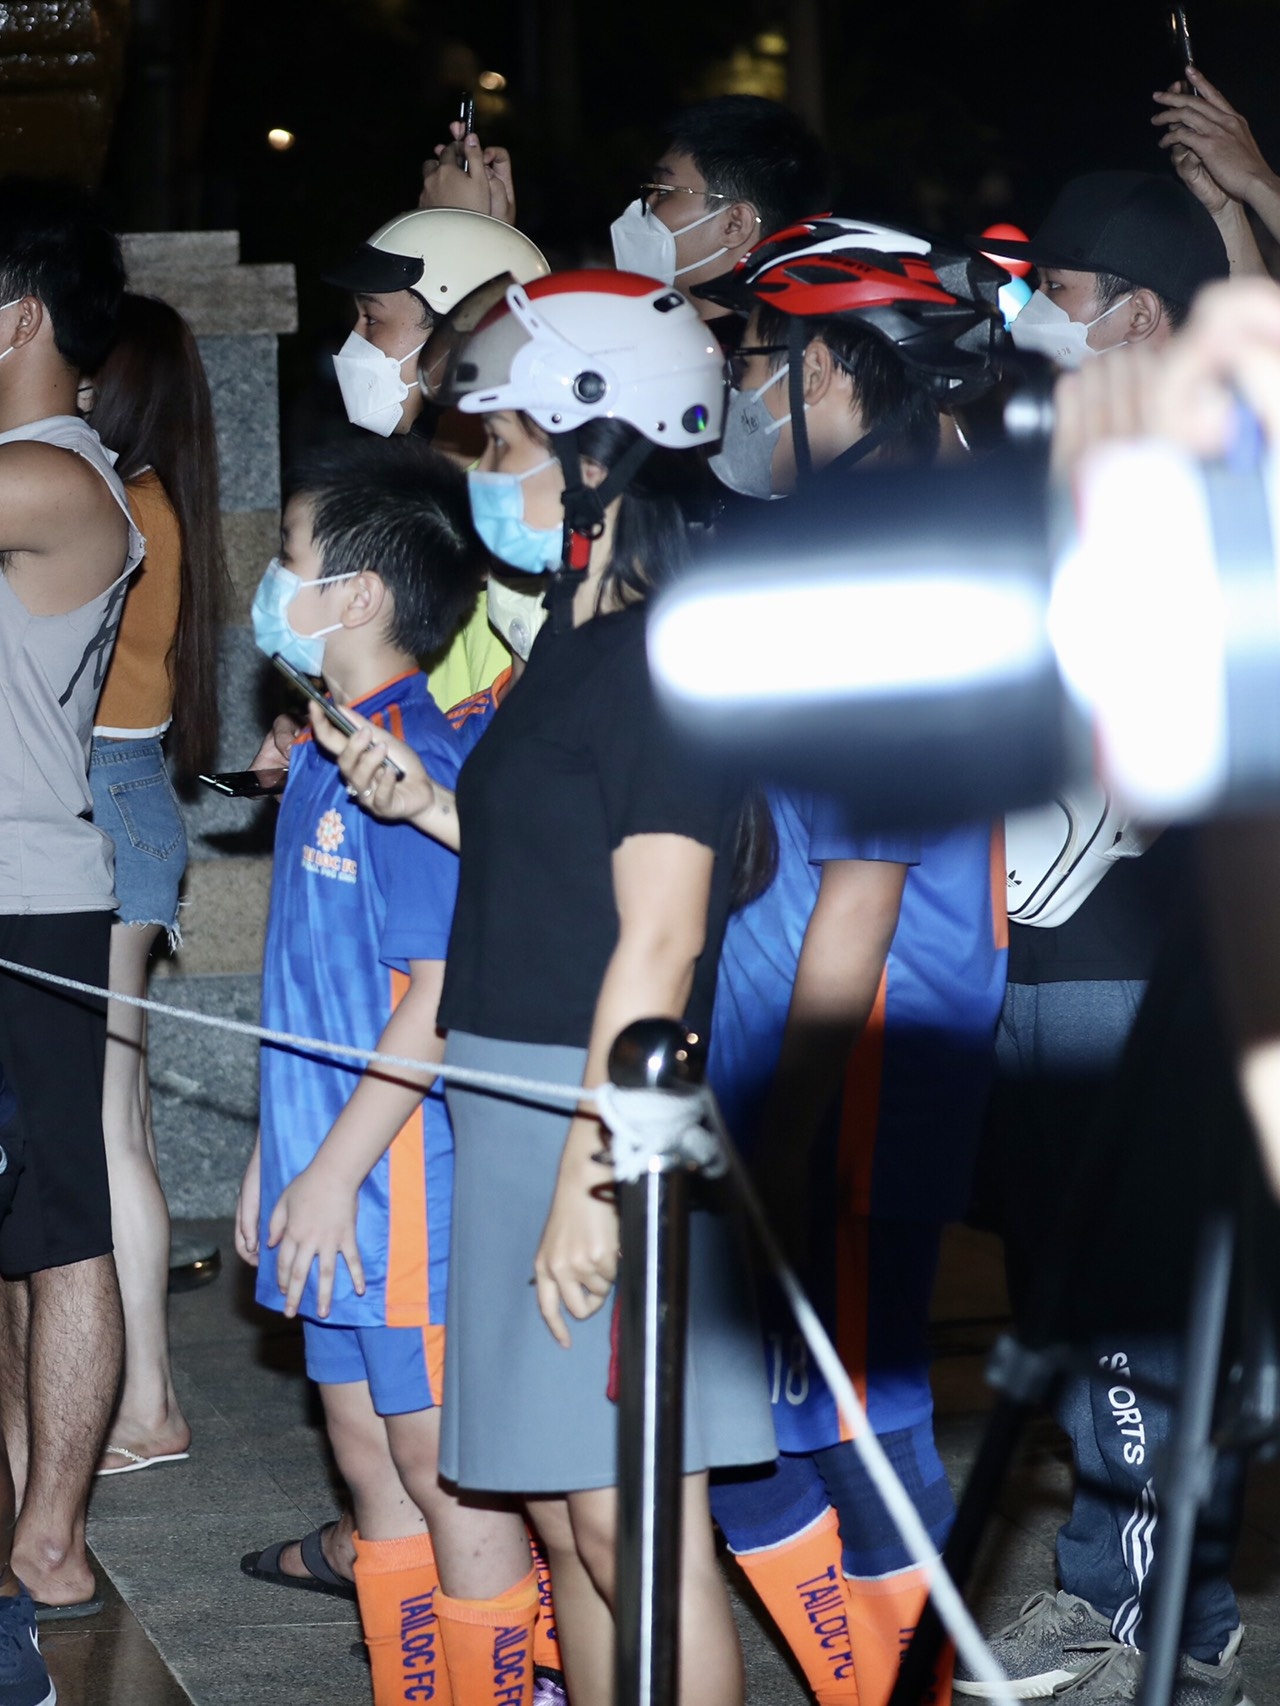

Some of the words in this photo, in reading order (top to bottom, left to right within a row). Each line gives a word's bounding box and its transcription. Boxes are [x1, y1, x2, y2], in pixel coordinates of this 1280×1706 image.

[1099, 1351, 1146, 1465] SORTS
[796, 1564, 851, 1649] TAILOC
[403, 1669, 436, 1702] FC
[492, 1625, 529, 1686] AILOC
